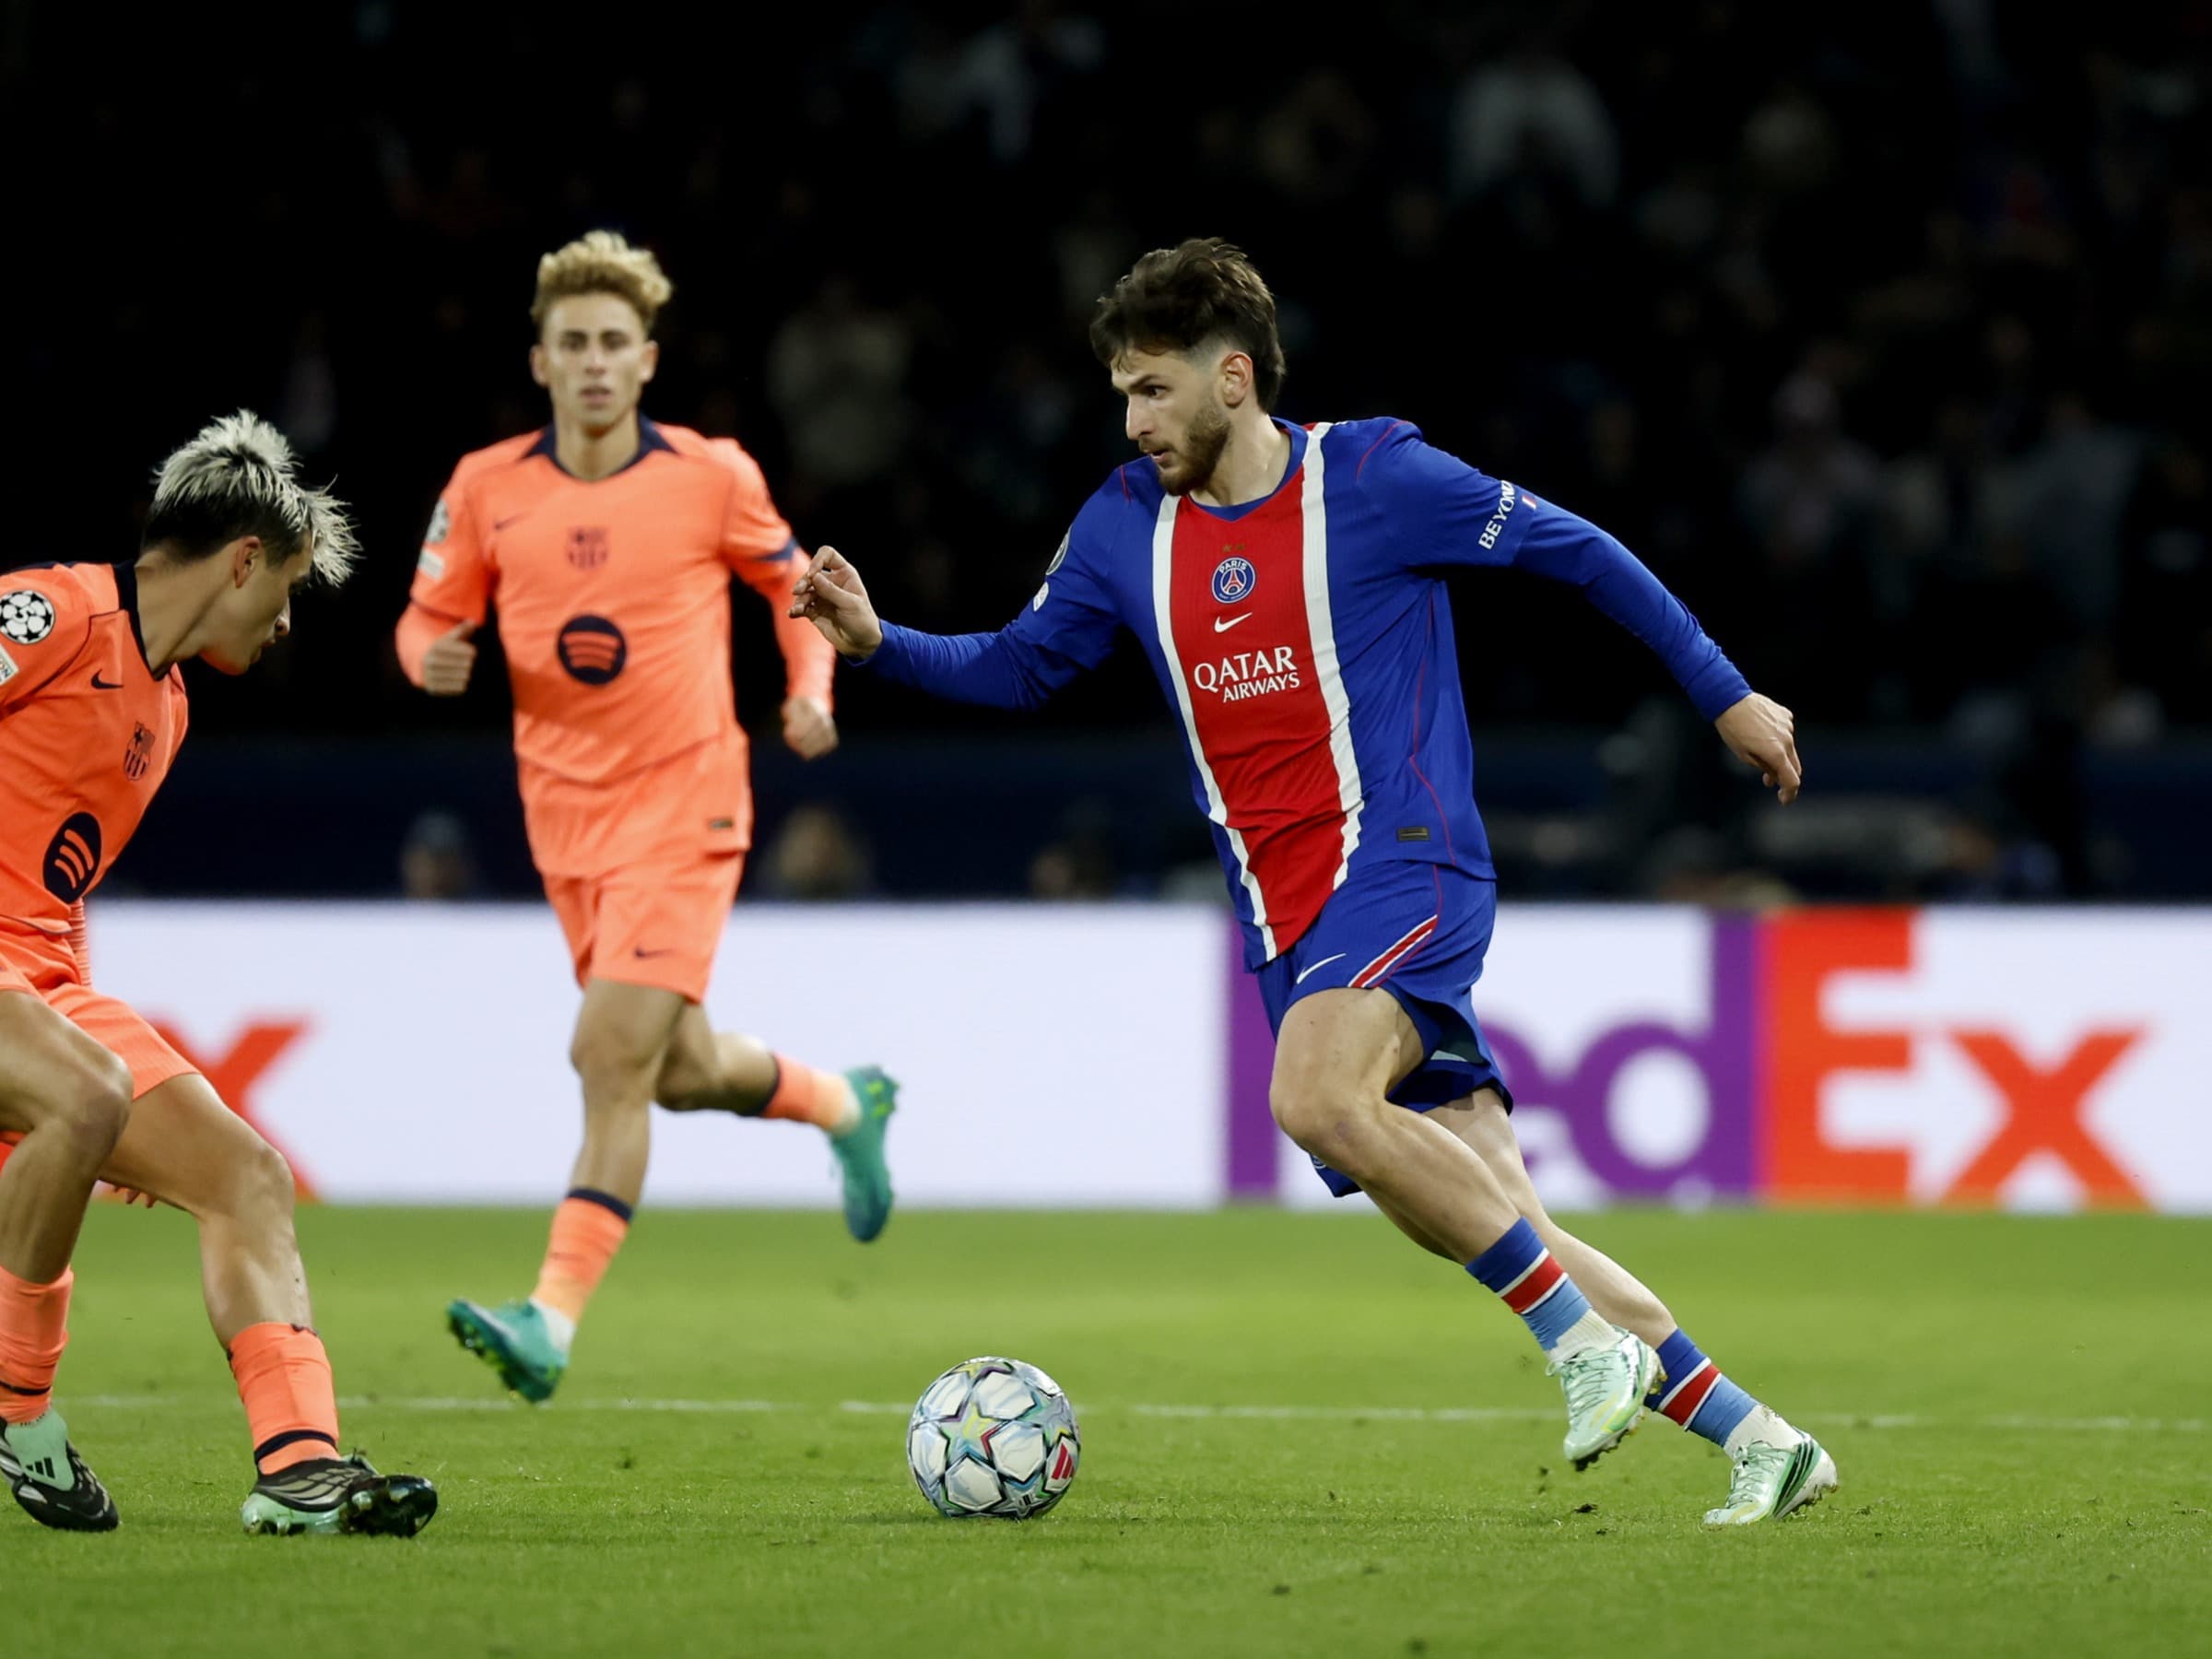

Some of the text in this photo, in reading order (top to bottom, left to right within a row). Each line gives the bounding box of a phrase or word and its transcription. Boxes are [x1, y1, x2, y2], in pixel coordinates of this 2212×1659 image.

[1218, 559, 1248, 573] PARIS
[1194, 645, 1298, 693] QATAR
[1222, 672, 1300, 703] AIRWAYS
